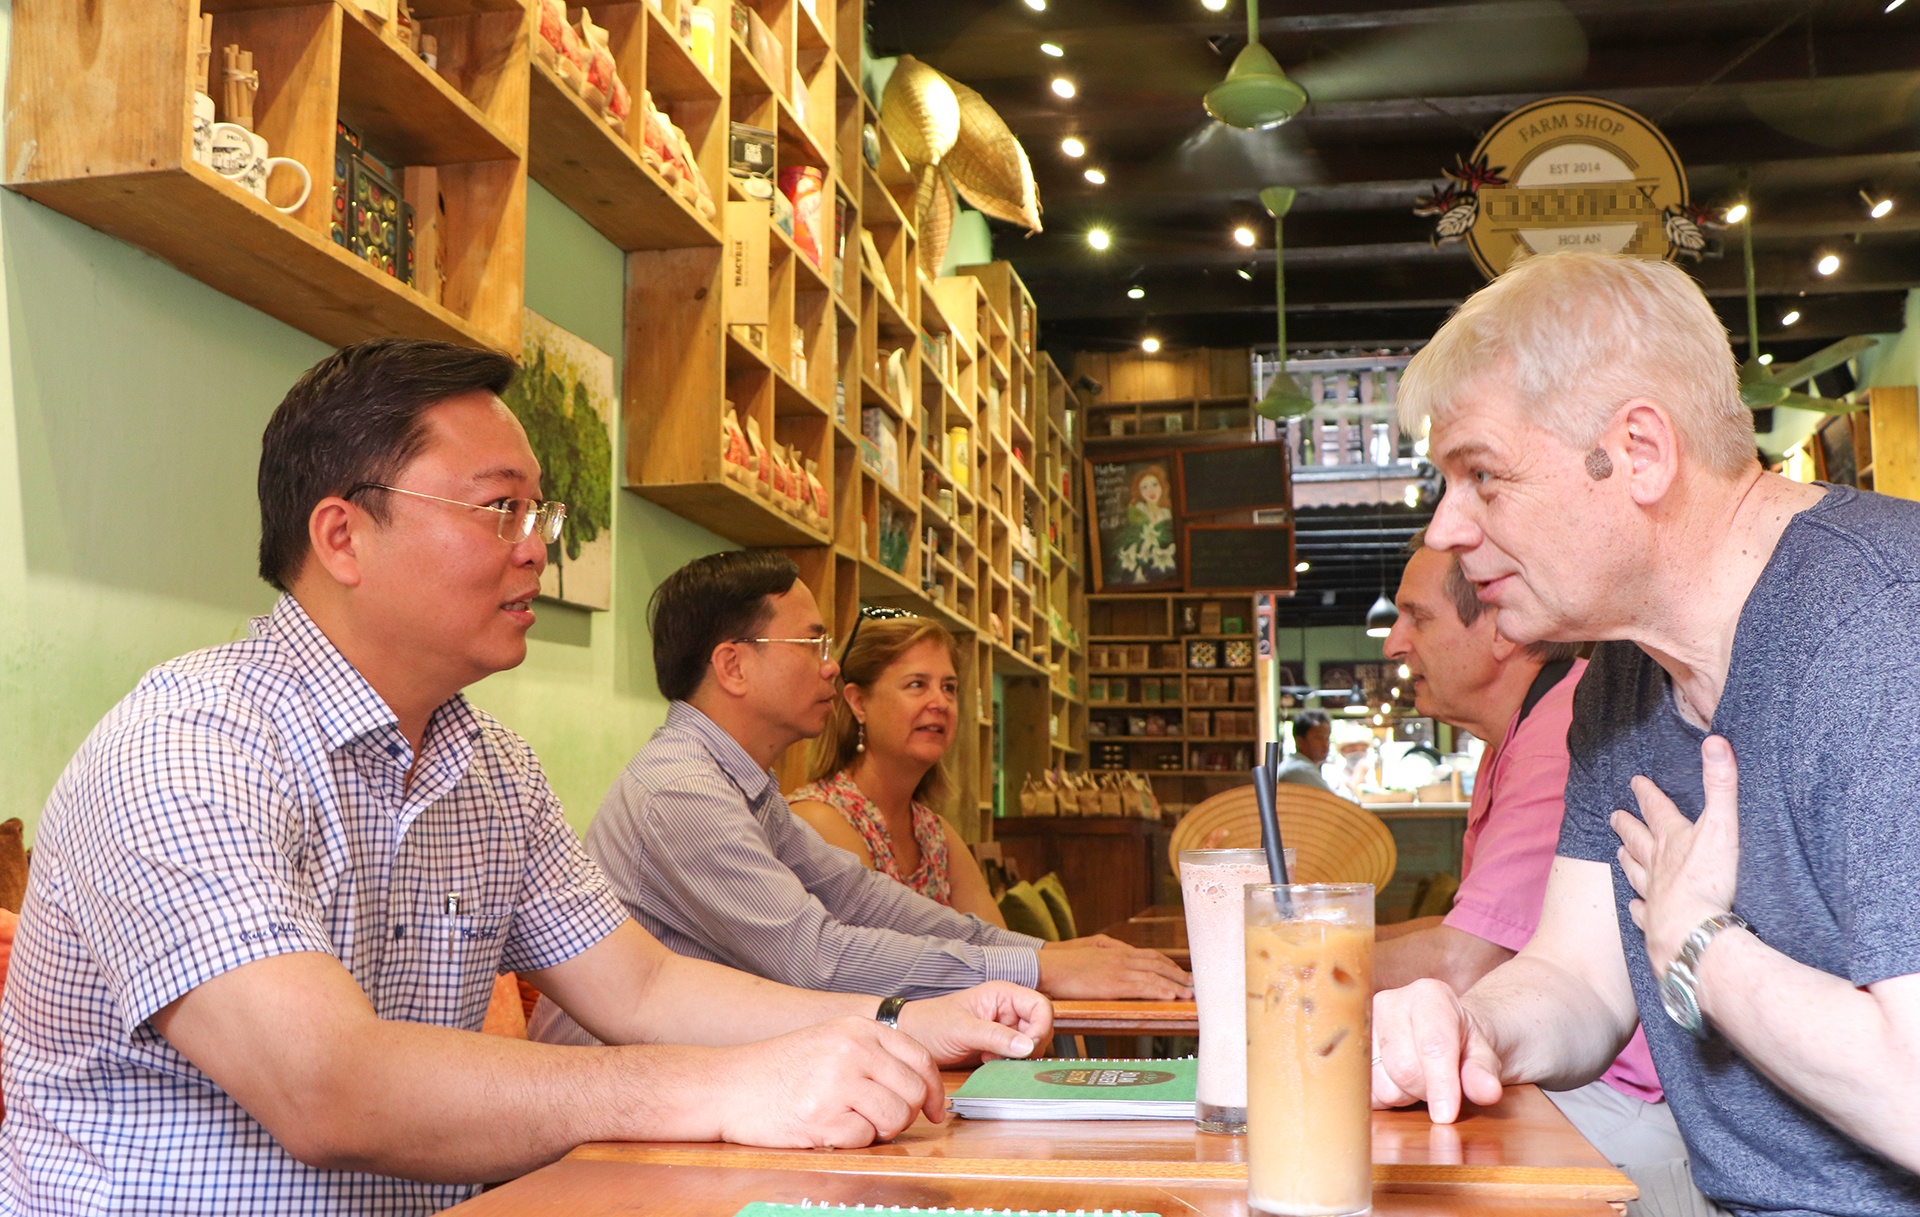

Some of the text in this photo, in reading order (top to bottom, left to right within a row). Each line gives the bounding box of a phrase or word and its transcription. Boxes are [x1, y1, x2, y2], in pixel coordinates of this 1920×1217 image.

[1518, 113, 1625, 143] FARM SHOP
[1549, 162, 1601, 174] EST 2014
[1558, 233, 1601, 246] HOI AN
